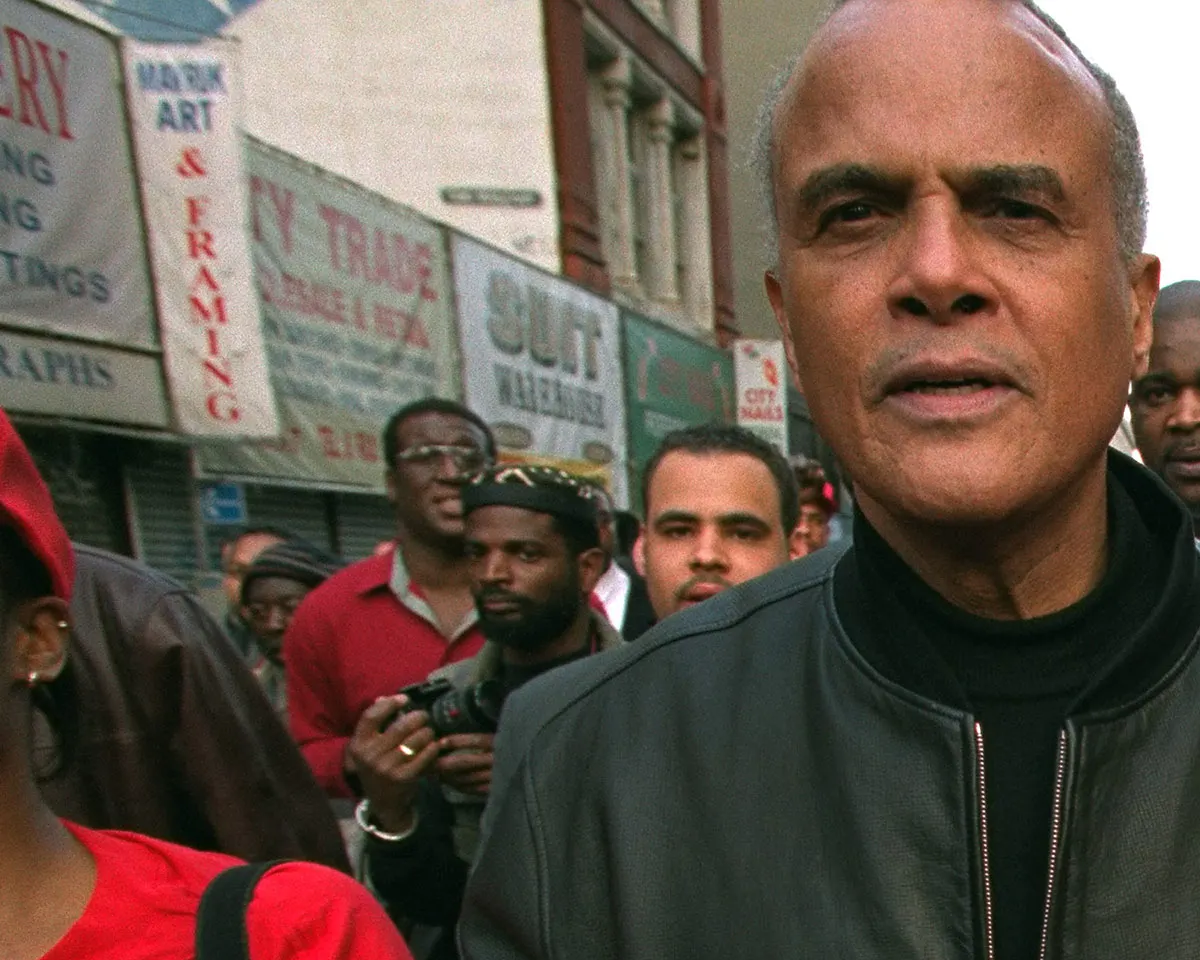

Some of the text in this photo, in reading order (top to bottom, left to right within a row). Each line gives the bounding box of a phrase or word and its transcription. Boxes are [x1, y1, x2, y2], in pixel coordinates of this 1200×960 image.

[0, 27, 75, 140] RY
[157, 98, 212, 133] ART
[177, 149, 240, 422] & FRAMING
[317, 203, 439, 301] TRADE
[487, 270, 602, 381] SUIT
